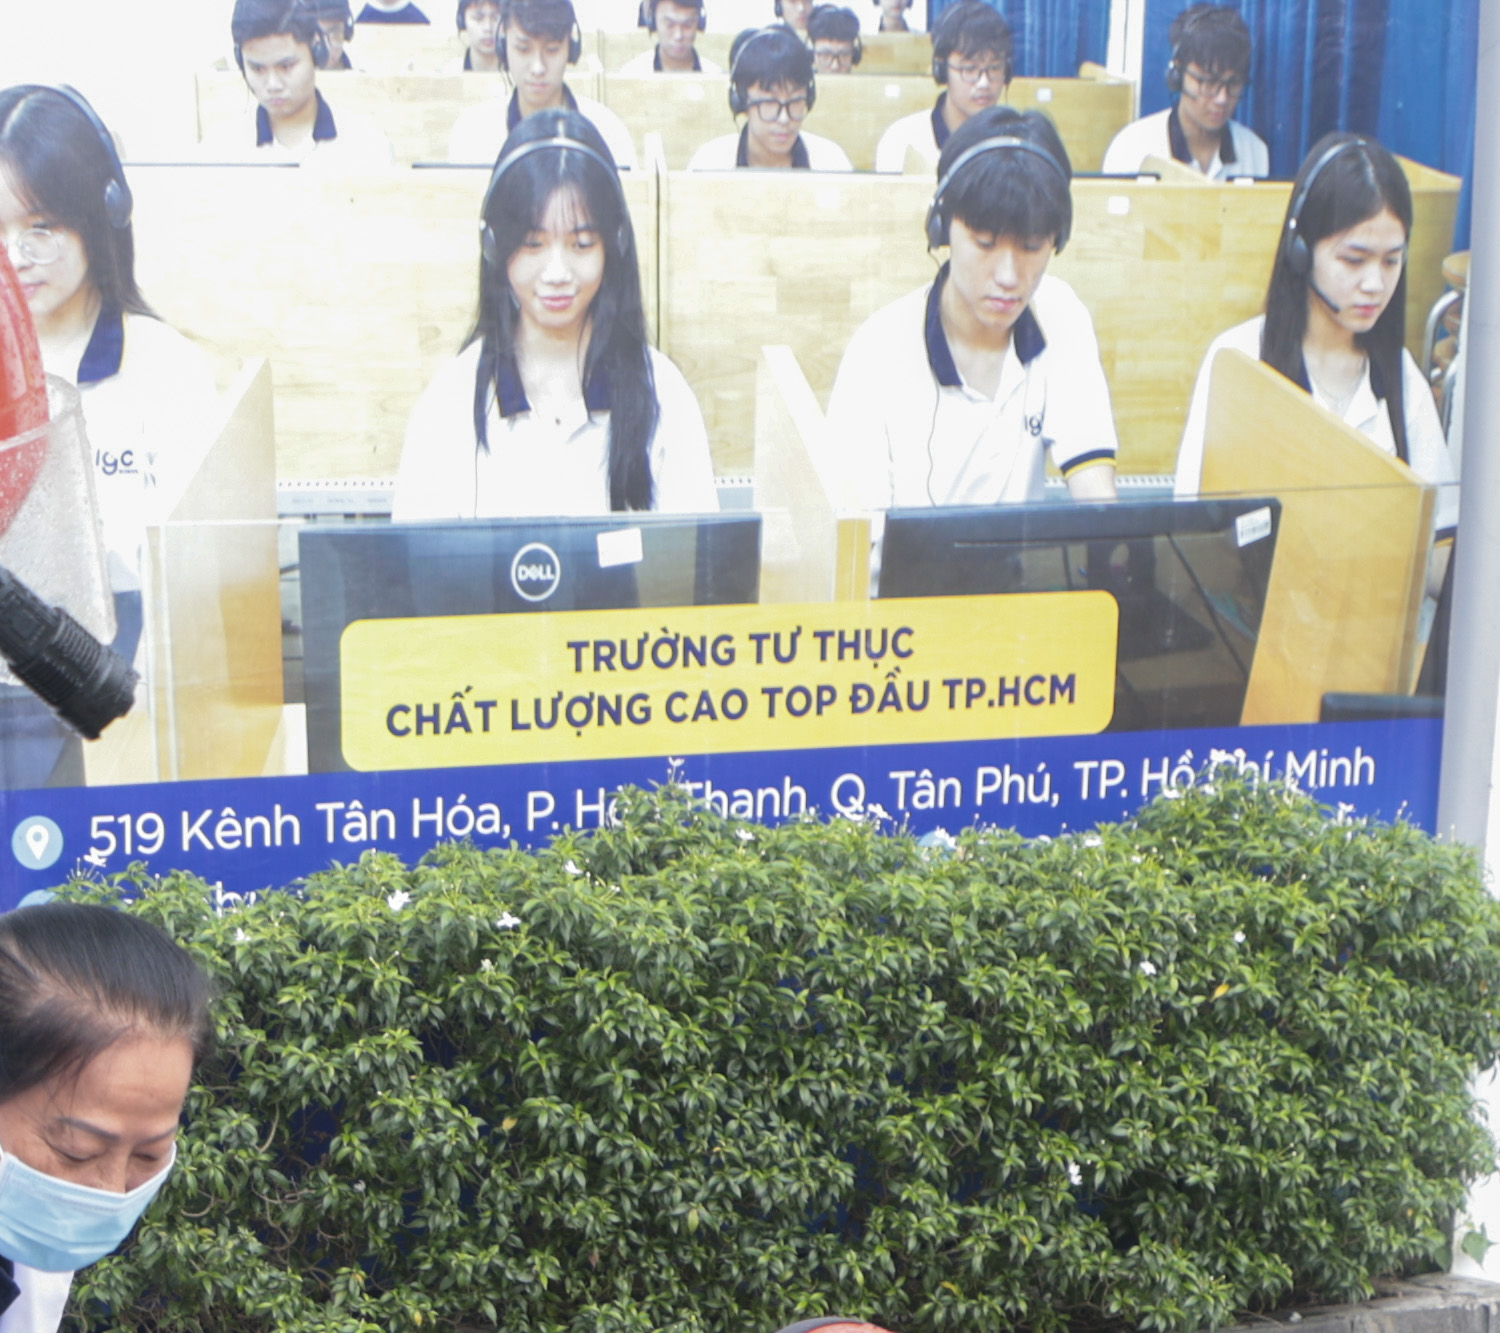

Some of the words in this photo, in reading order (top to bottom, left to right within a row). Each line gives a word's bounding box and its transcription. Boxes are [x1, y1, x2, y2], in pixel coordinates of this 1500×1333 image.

[518, 564, 555, 581] DELL
[567, 626, 736, 673] TRƯỜNG
[749, 625, 802, 665] TƯ
[813, 626, 915, 668] THỤC
[386, 685, 498, 737] CHẤT
[511, 691, 652, 737] LƯỢNG
[665, 688, 749, 723] CAO
[761, 683, 838, 719] TOP
[849, 666, 931, 715] ĐẦU
[943, 673, 1076, 710] TP.HCM
[89, 813, 165, 856] 519
[181, 803, 301, 852] Kênh
[315, 799, 397, 844] Tân
[412, 793, 512, 839] Hóa,
[527, 790, 560, 832] P.
[889, 768, 962, 811] Tân
[975, 762, 1060, 808] Phú,
[1073, 760, 1128, 800] TP.
[1141, 749, 1195, 797] Hồ
[1285, 746, 1376, 790] Minh
